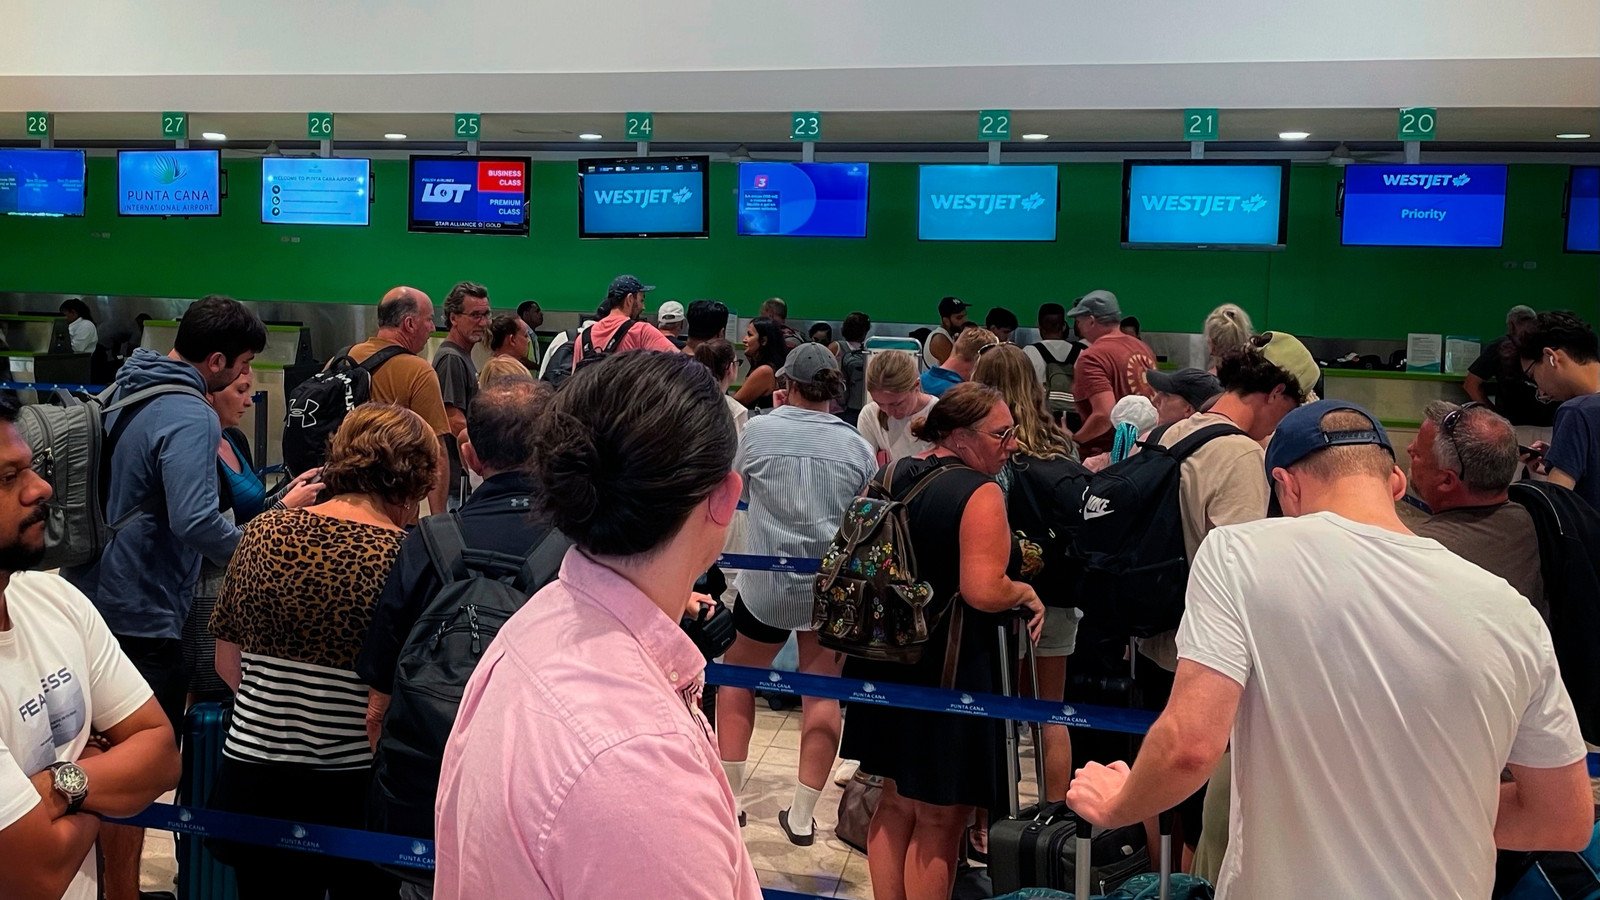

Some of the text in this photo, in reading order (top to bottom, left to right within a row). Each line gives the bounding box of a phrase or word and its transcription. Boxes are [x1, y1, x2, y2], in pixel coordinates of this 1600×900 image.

[28, 117, 47, 132] 28
[164, 117, 184, 132] 27
[310, 117, 331, 133] 26
[457, 118, 479, 134] 25
[628, 118, 651, 135] 24
[795, 117, 819, 134] 23
[982, 116, 1008, 133] 22
[1189, 115, 1214, 133] 21
[1402, 114, 1434, 133] 20
[1383, 174, 1452, 189] WESTJET
[127, 190, 210, 201] PUNTA CANA
[421, 183, 472, 203] LOT
[594, 188, 671, 209] WESTJET
[125, 203, 213, 211] INTERNATIONAL AIRPORT
[930, 194, 1020, 215] WESTJET
[1141, 194, 1241, 217] WESTJET
[1401, 208, 1447, 221] Priority
[18, 666, 72, 722] FEAESS
[302, 840, 320, 848] CANA
[399, 854, 421, 862] PUNTA
